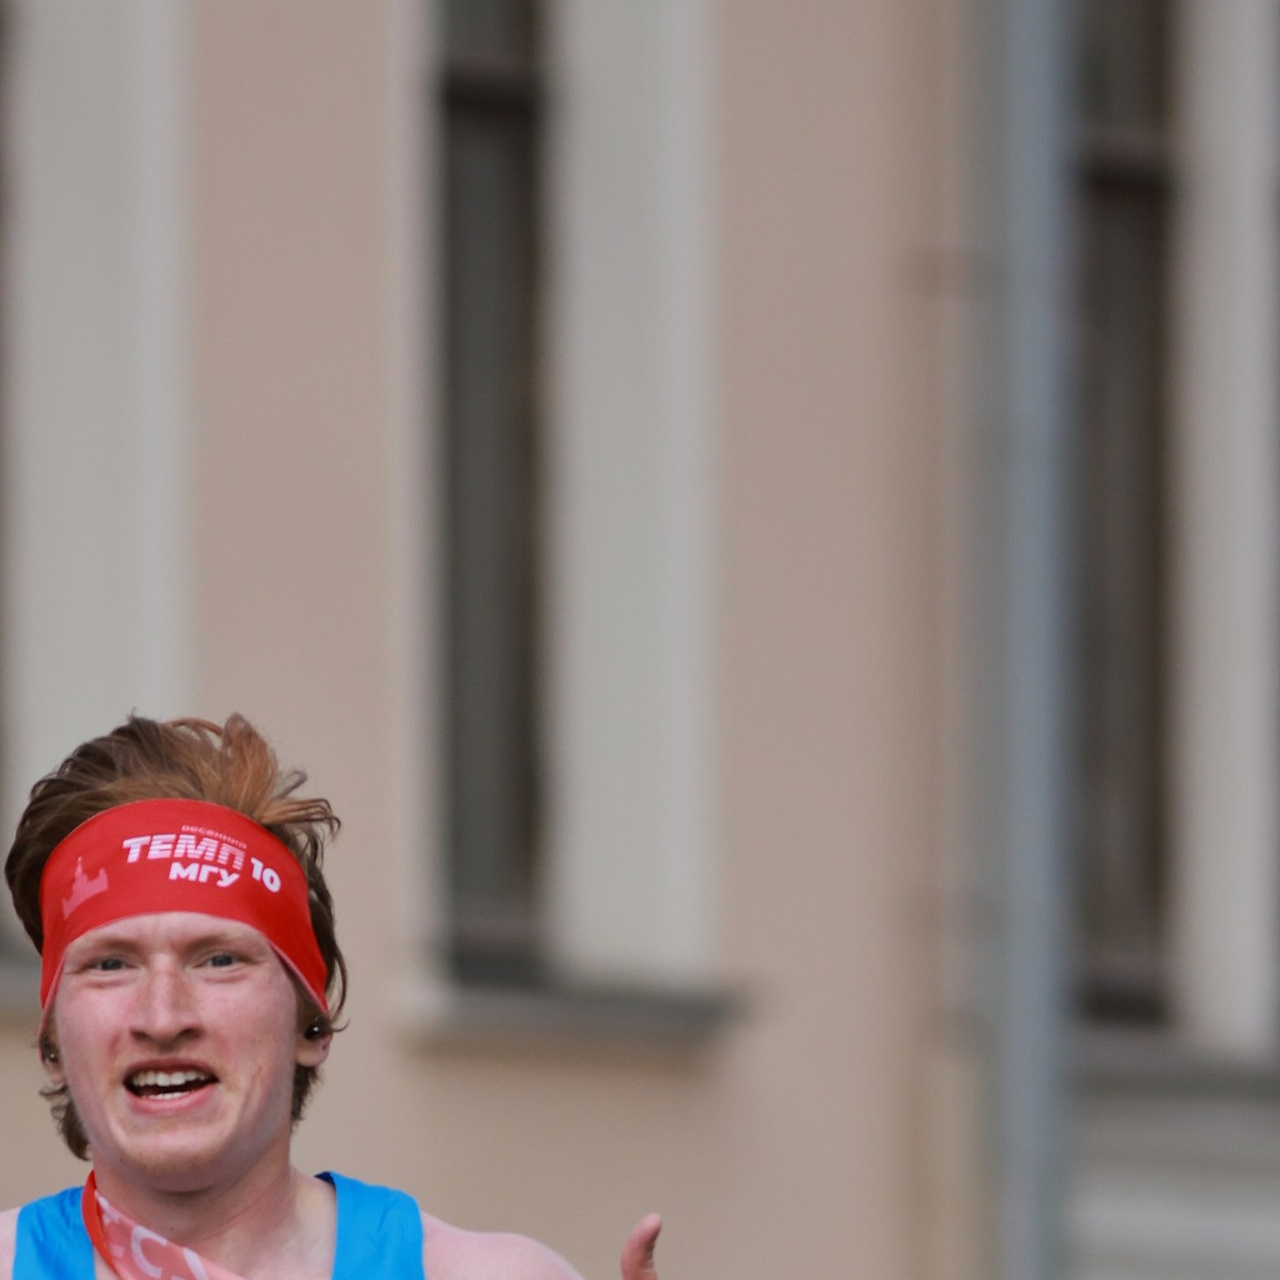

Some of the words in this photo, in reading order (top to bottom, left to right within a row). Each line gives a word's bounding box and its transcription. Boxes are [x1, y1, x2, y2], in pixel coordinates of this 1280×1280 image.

[122, 833, 246, 871] ТЕМП
[169, 861, 240, 888] МГУ
[250, 856, 281, 893] 10
